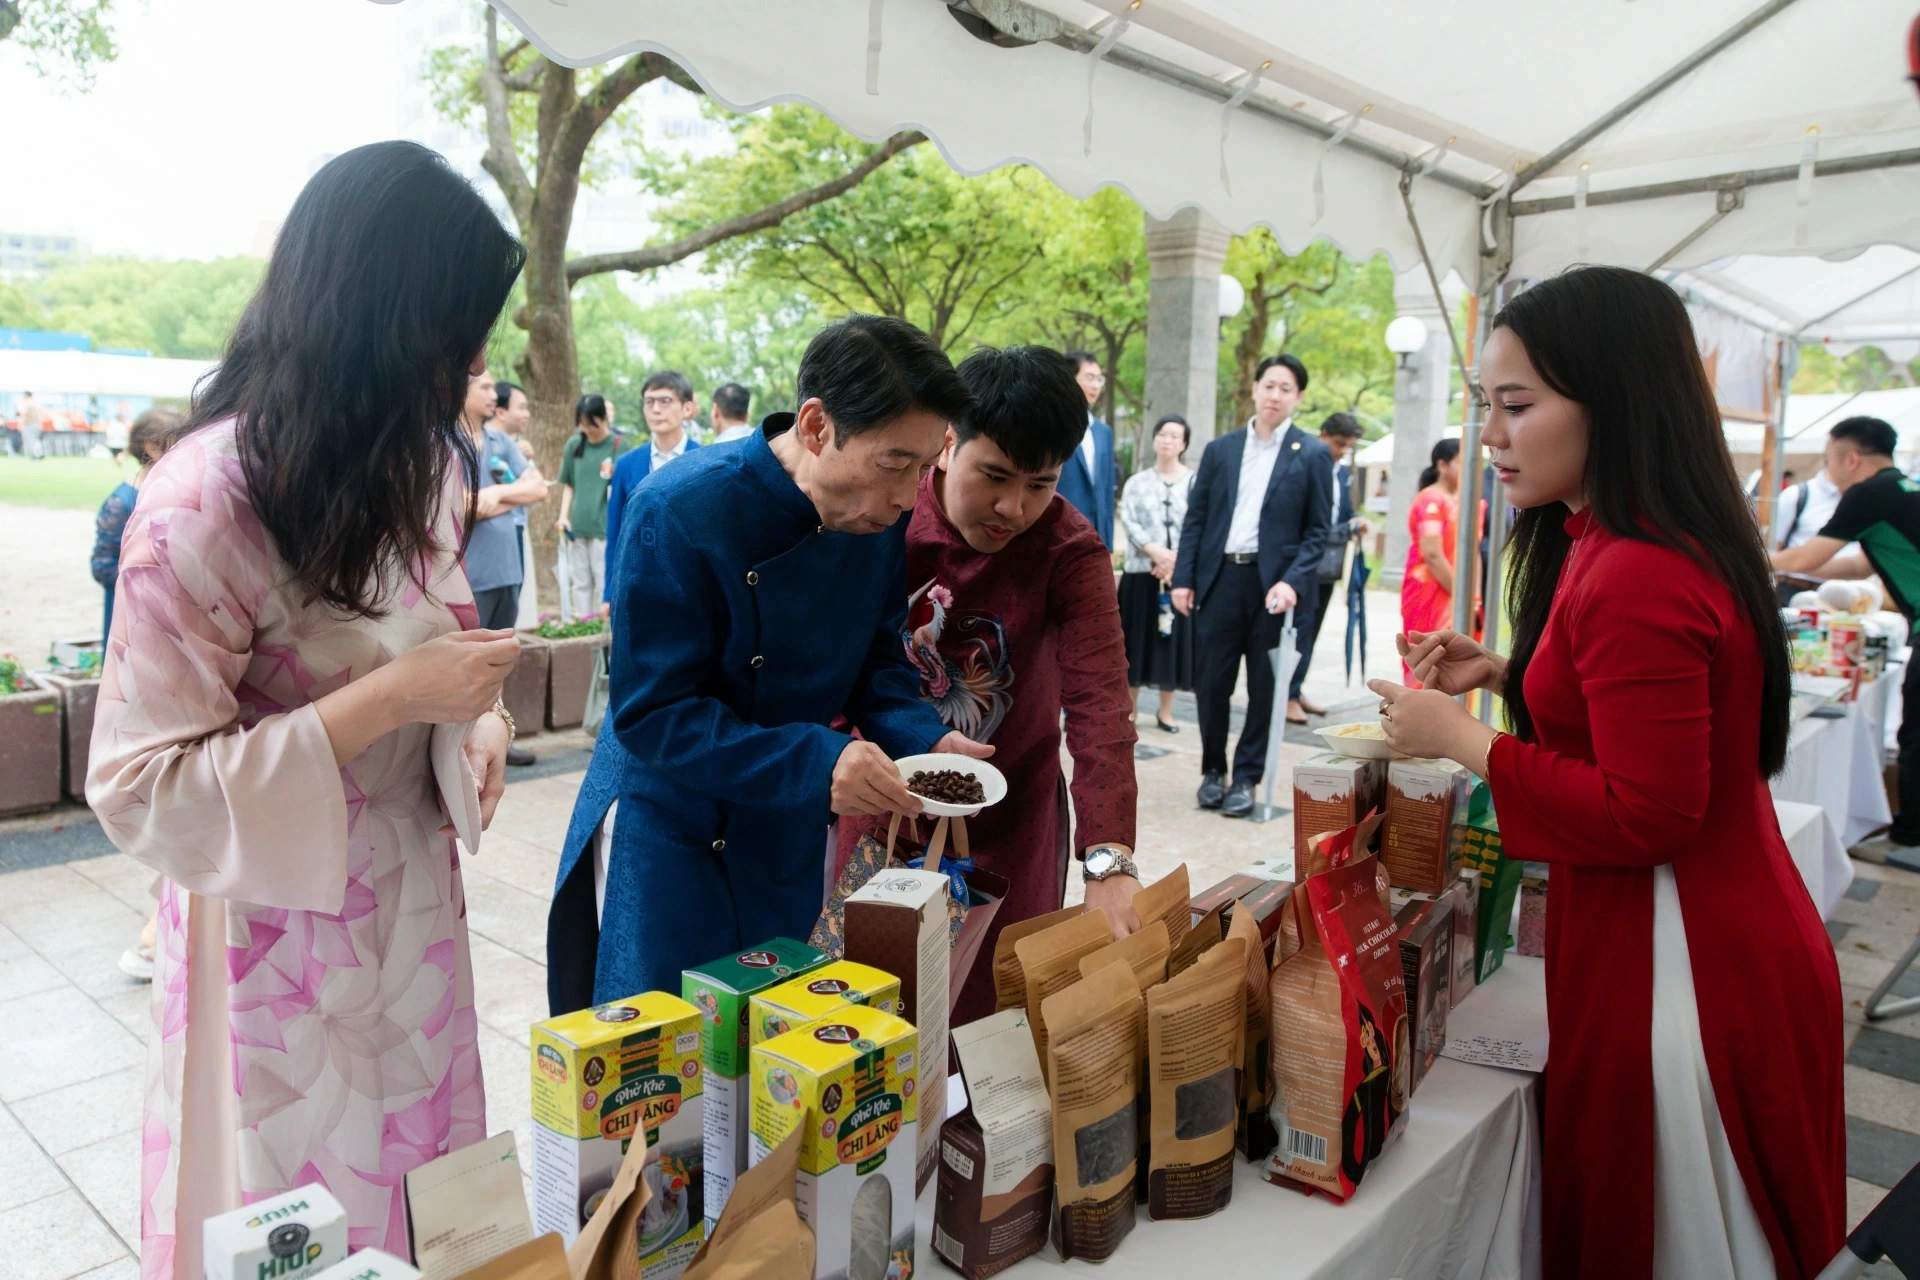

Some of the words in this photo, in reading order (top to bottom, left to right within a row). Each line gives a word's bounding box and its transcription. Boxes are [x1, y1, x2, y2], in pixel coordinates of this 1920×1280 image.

[1352, 880, 1363, 898] 36
[1373, 943, 1391, 960] DRINK
[615, 1082, 643, 1105] Phở
[643, 1079, 666, 1096] Khô
[605, 1112, 634, 1134] CHI
[851, 1104, 872, 1128] Phở
[874, 1098, 891, 1115] Khô
[842, 1136, 864, 1158] CHI
[866, 1118, 899, 1149] LĂNG
[1294, 1165, 1315, 1179] thanh
